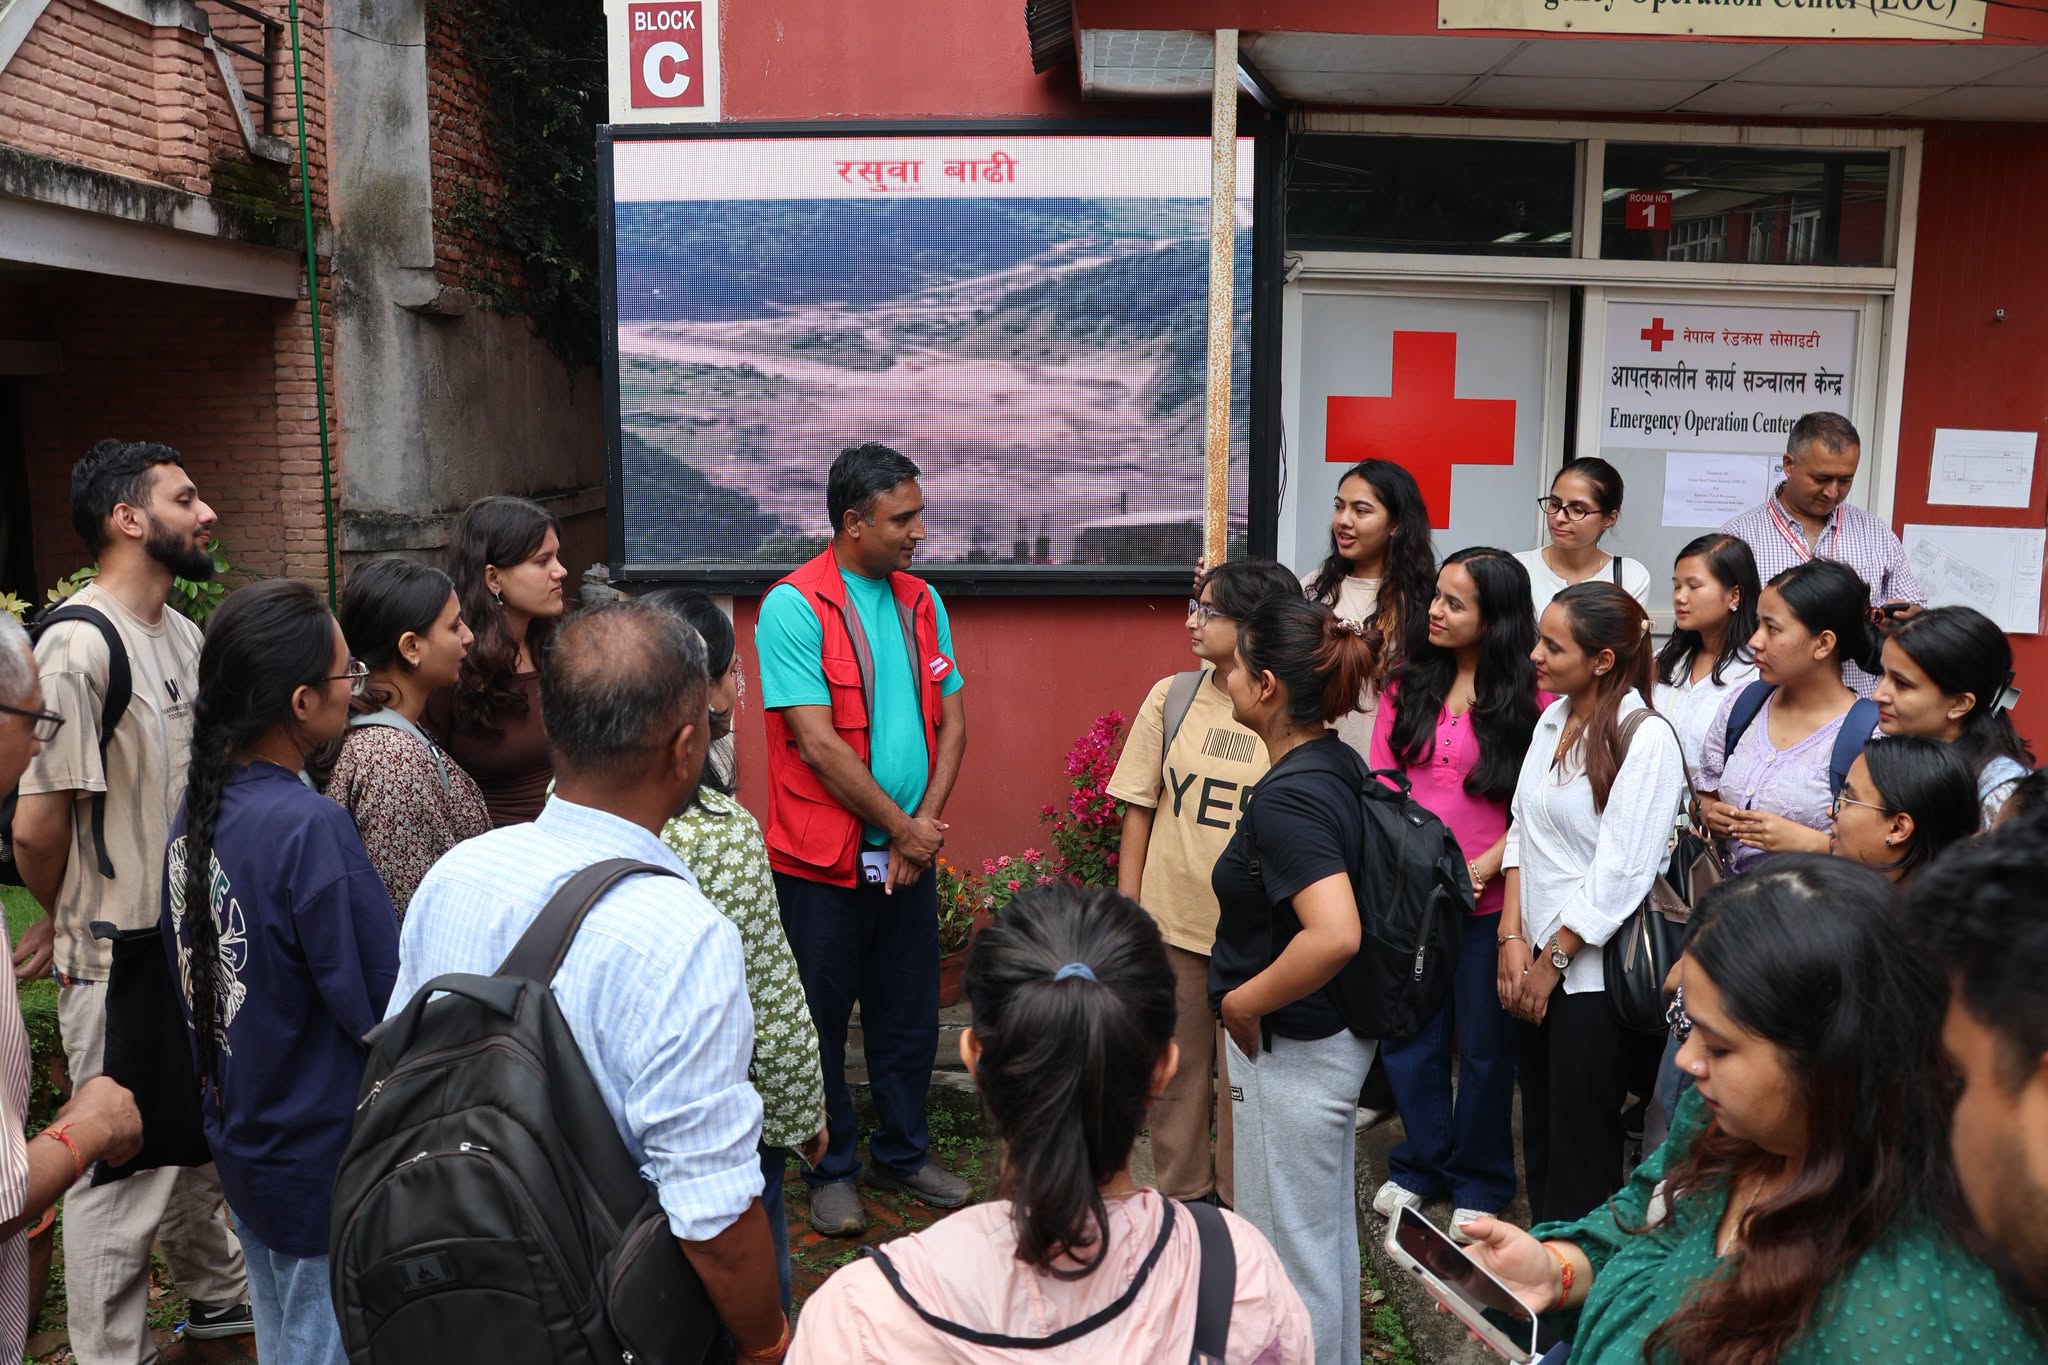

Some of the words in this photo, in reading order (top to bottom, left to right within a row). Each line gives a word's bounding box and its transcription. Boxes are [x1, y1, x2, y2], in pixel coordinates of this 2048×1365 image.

[635, 10, 696, 31] BLOCK
[643, 41, 691, 99] C
[834, 160, 924, 192] रसुवा
[943, 150, 1018, 182] बाढी
[1630, 194, 1654, 203] ROOM
[1655, 195, 1669, 203] NO.
[1642, 205, 1656, 227] 1
[1683, 327, 1716, 344] नेपाल
[1722, 328, 1763, 346] रेडक्रस
[1769, 330, 1821, 349] सोसाइटी
[1705, 362, 1736, 392] कार्य
[1743, 371, 1807, 395] सञ्चालन
[1814, 366, 1845, 396] केन्द्र
[1610, 407, 1681, 436] Emergency
[1684, 409, 1748, 436] Operation
[1752, 411, 1796, 433] Center
